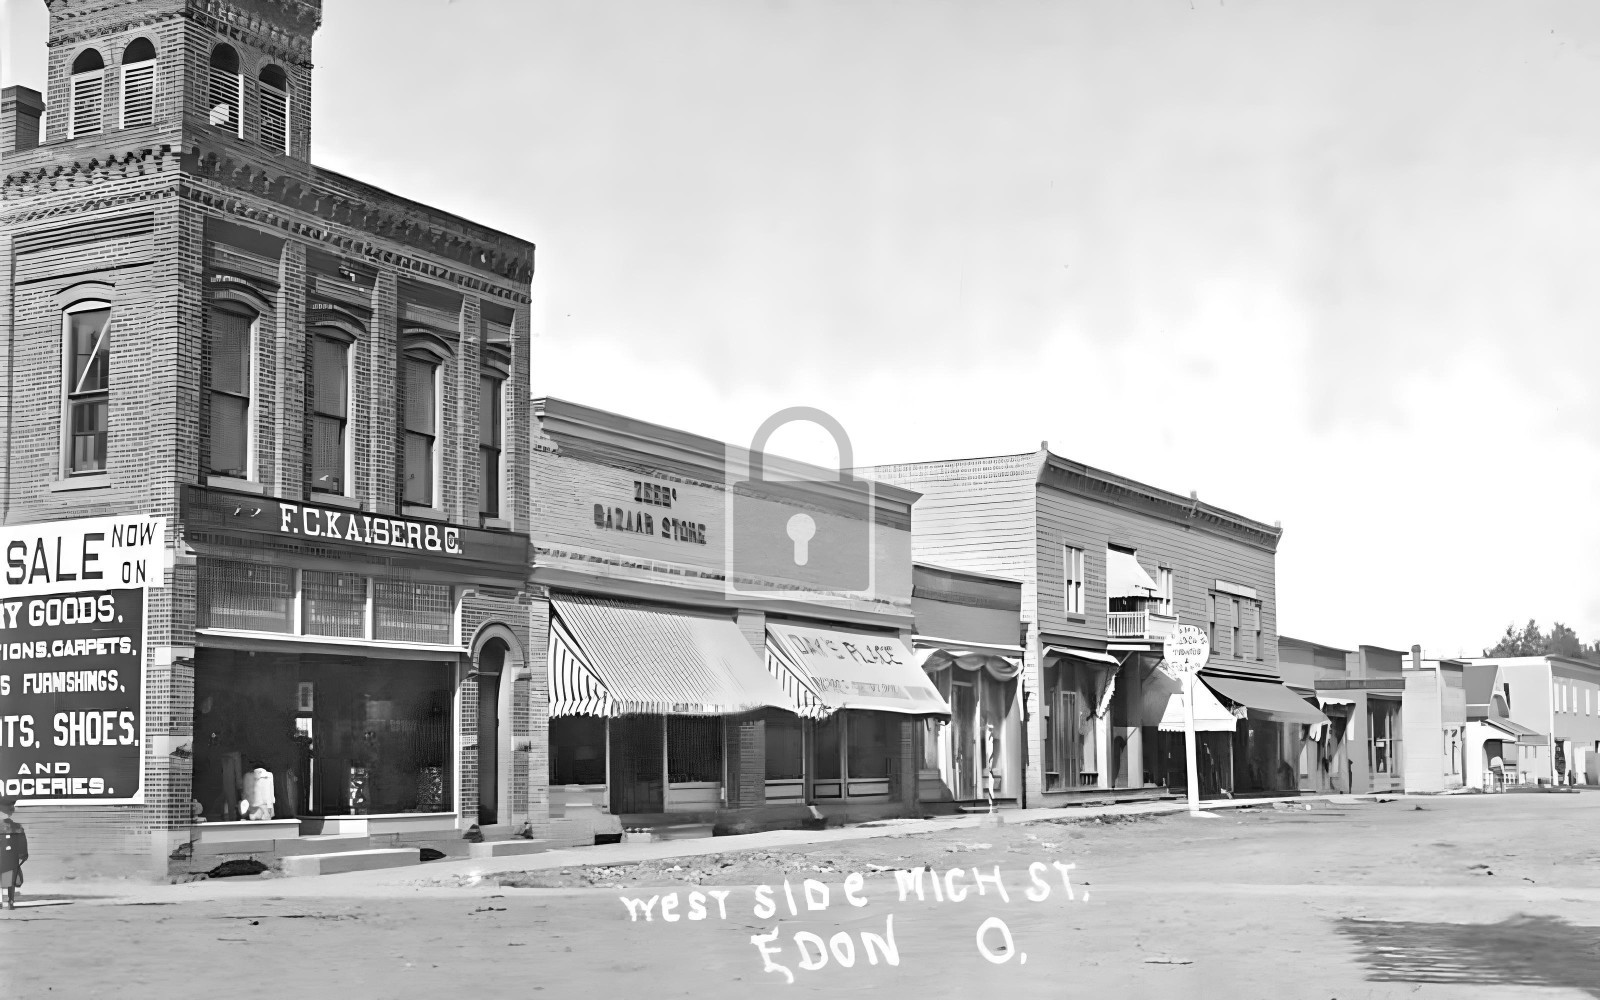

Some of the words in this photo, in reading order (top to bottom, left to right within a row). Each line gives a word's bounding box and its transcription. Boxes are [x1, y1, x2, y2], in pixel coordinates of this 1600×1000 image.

[111, 522, 158, 548] NOW
[6, 533, 105, 585] SALE
[121, 560, 146, 584] ON
[18, 762, 71, 775] AND
